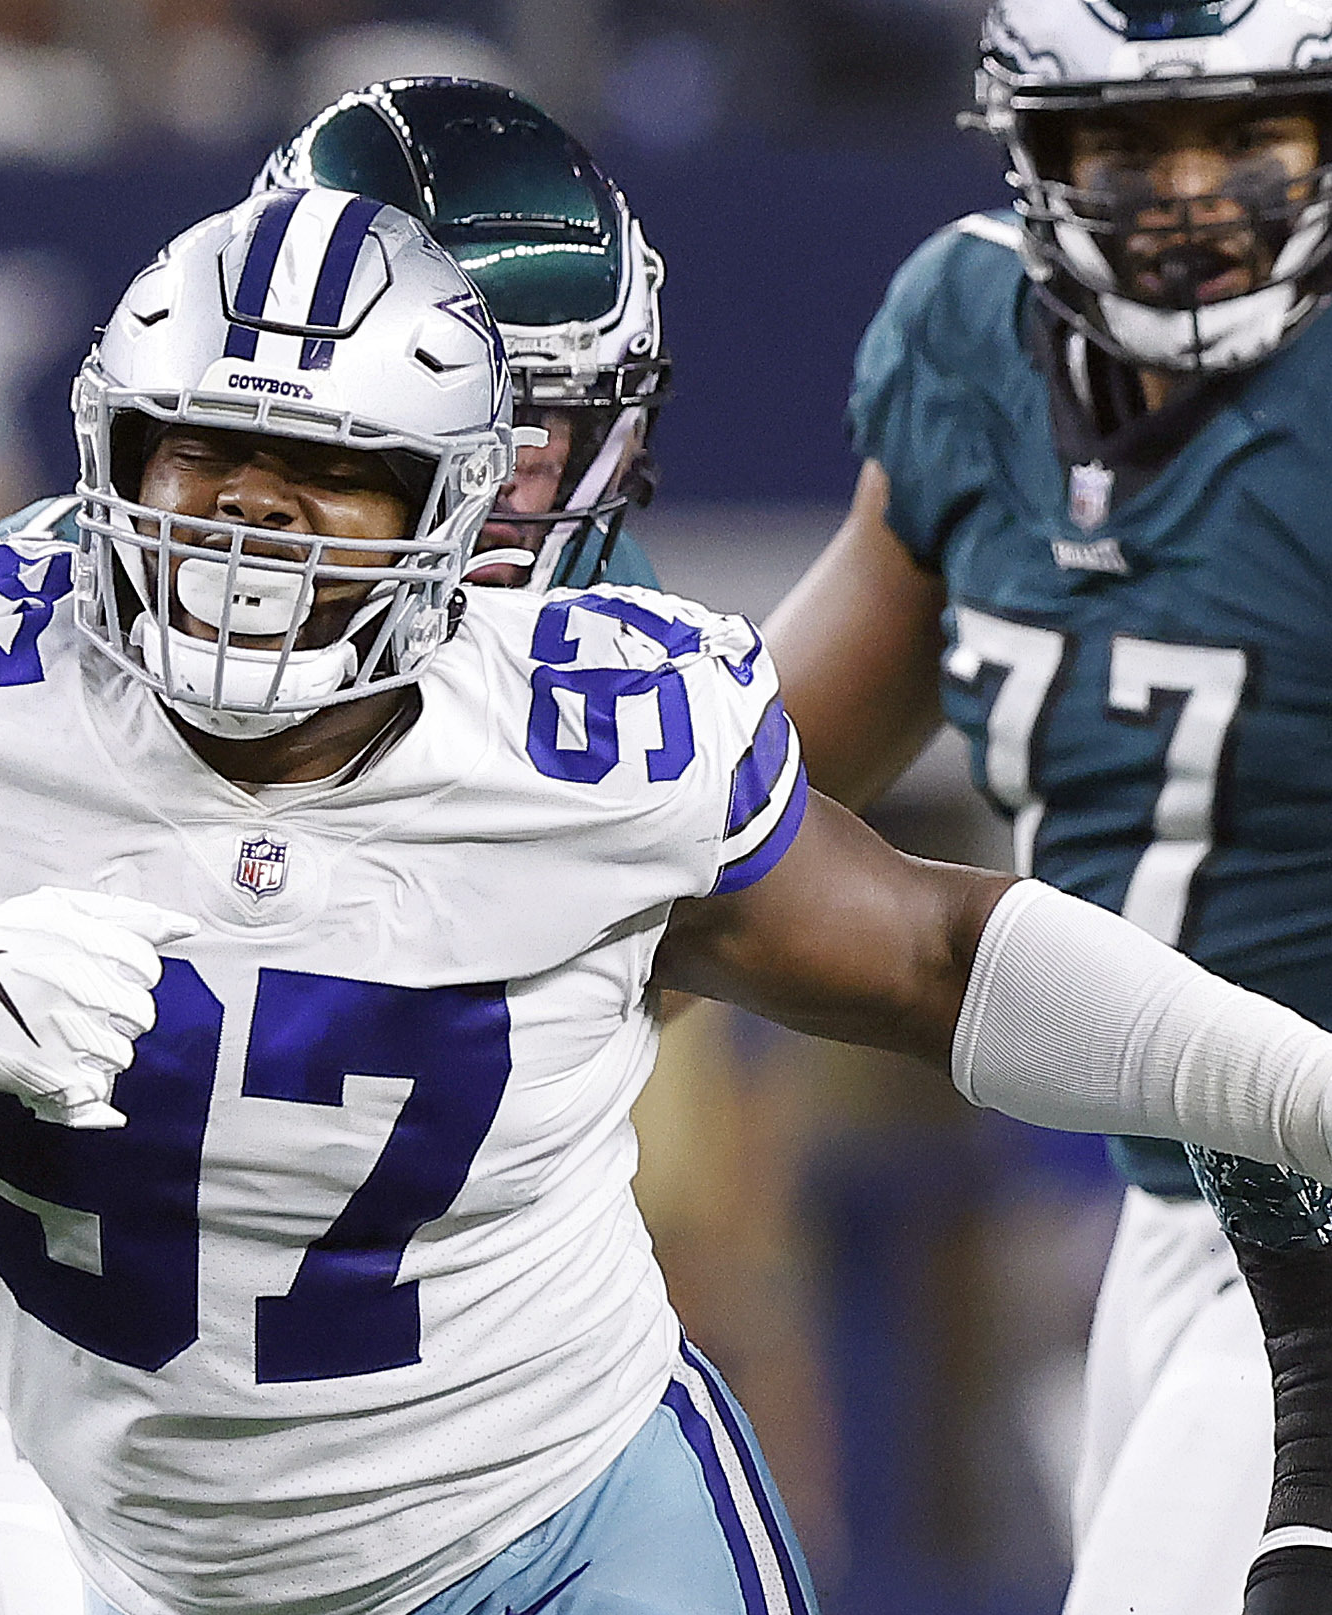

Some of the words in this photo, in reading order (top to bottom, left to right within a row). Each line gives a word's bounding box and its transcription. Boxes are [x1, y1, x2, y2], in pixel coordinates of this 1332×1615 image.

[228, 373, 313, 400] COWBOYS
[945, 604, 1248, 948] 77
[241, 860, 277, 888] NFL
